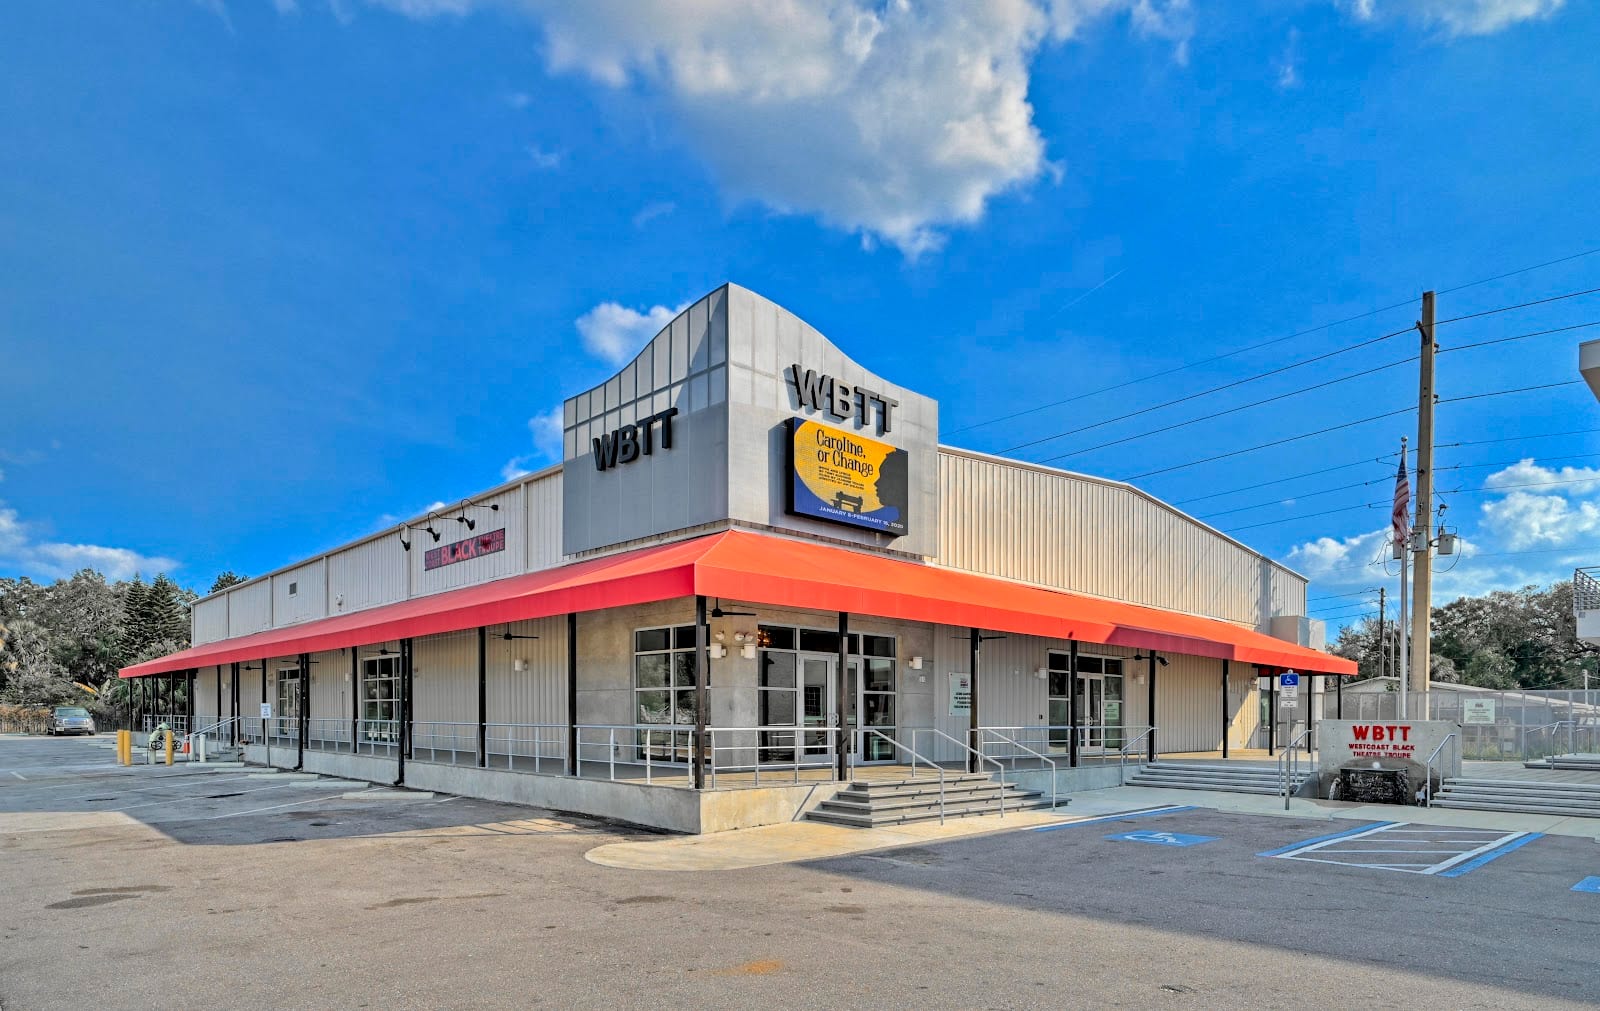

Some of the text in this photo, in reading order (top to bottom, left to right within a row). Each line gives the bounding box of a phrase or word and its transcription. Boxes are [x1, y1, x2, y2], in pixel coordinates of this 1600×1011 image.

[791, 364, 898, 432] WBTT
[592, 407, 678, 471] WBTT
[816, 429, 866, 459] Caroline,
[817, 450, 830, 463] or
[832, 449, 874, 477] Change
[819, 506, 847, 516] JANUARY
[441, 538, 477, 566] BLACK
[1352, 725, 1412, 741] WBTT
